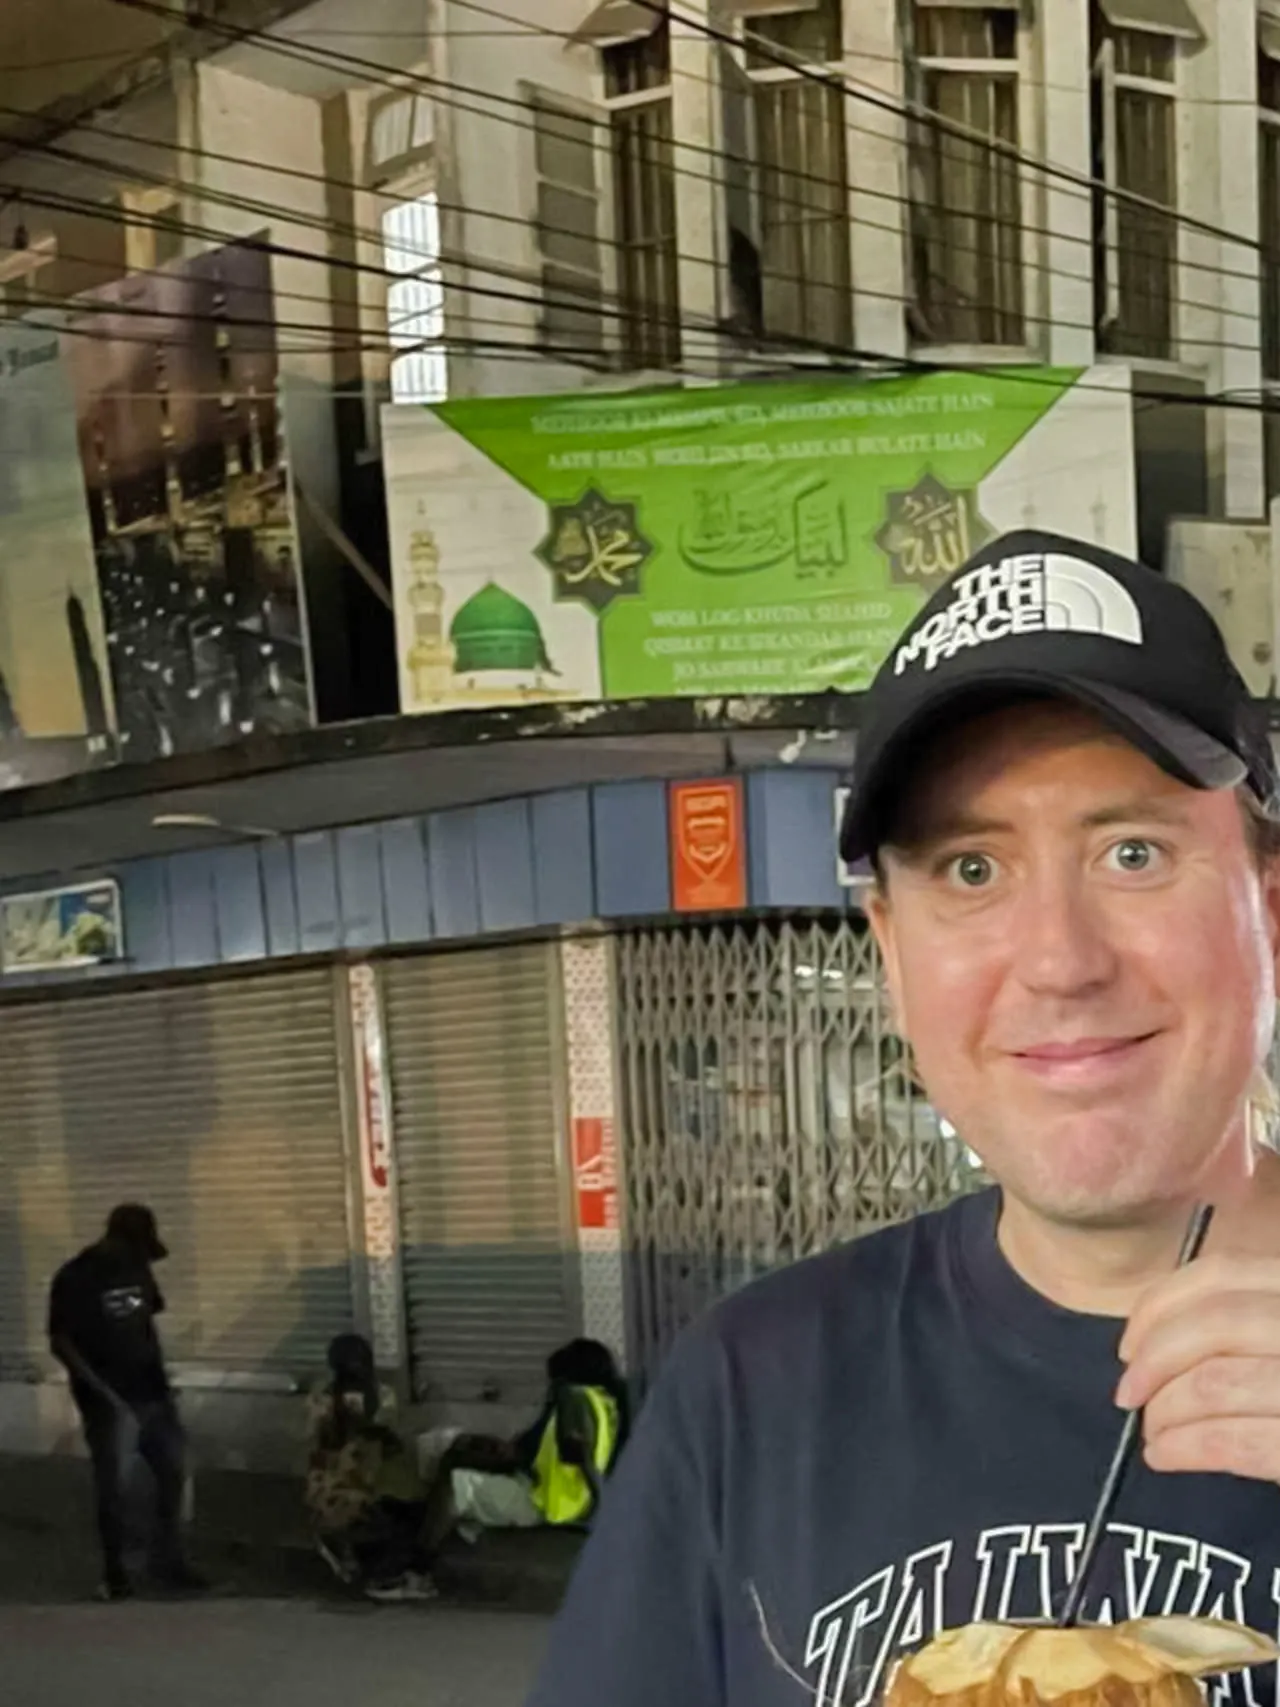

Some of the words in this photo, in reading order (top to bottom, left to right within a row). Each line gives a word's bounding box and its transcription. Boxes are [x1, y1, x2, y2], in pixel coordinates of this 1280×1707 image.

[952, 553, 1043, 602] THE
[894, 578, 1043, 676] NORTH
[925, 607, 1044, 670] FACE
